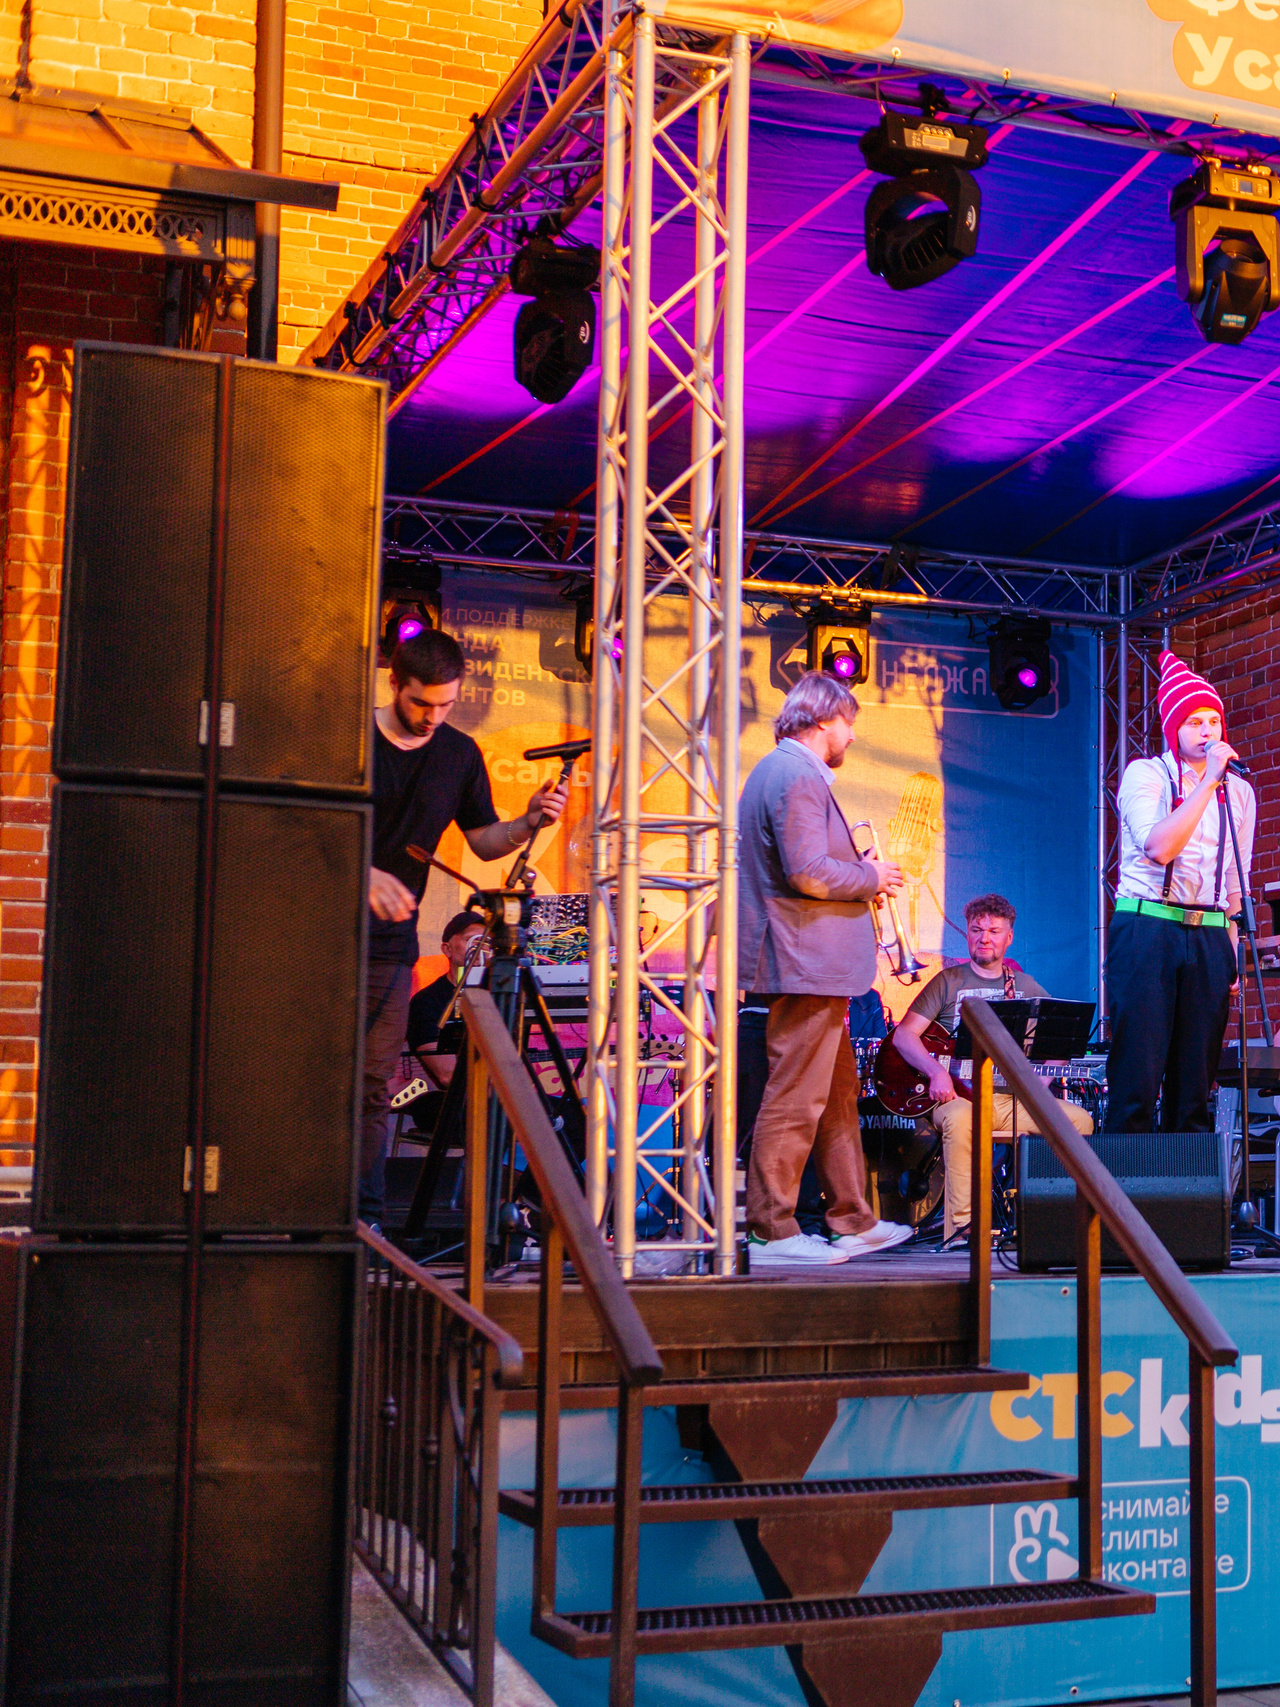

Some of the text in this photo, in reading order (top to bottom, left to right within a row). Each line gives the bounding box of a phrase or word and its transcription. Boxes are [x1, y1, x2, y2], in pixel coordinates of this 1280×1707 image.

[456, 608, 574, 630] ПОДДЕРЖКЕ
[453, 631, 506, 654] НДА
[463, 658, 590, 684] ЗИДЕНТСК
[457, 685, 526, 706] НТОВ
[866, 1115, 916, 1129] YAMAHA
[1102, 1528, 1178, 1551] липы
[1102, 1554, 1234, 1582] контае
